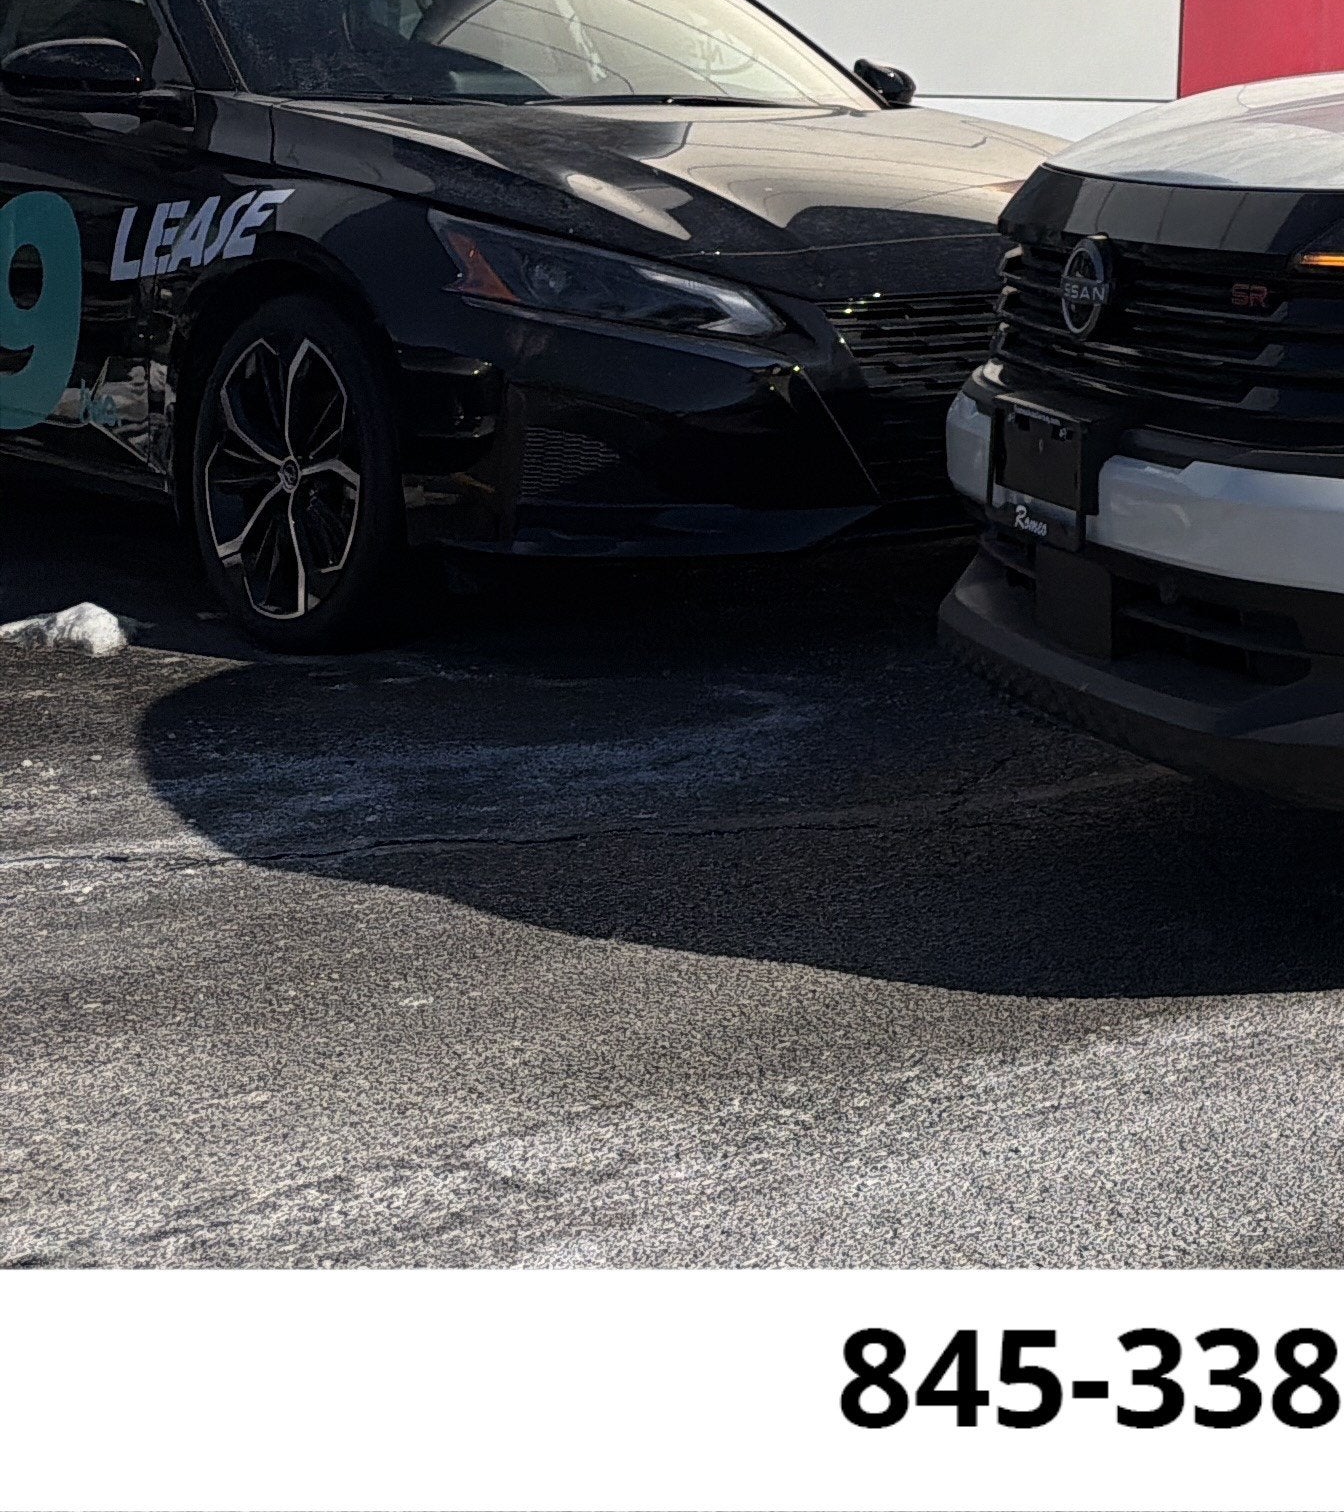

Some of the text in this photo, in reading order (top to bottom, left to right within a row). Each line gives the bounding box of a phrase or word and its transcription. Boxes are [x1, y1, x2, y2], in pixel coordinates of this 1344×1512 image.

[110, 189, 295, 281] LEASE
[0, 191, 82, 430] 9
[1063, 283, 1106, 301] SSAN
[1232, 283, 1267, 308] SR
